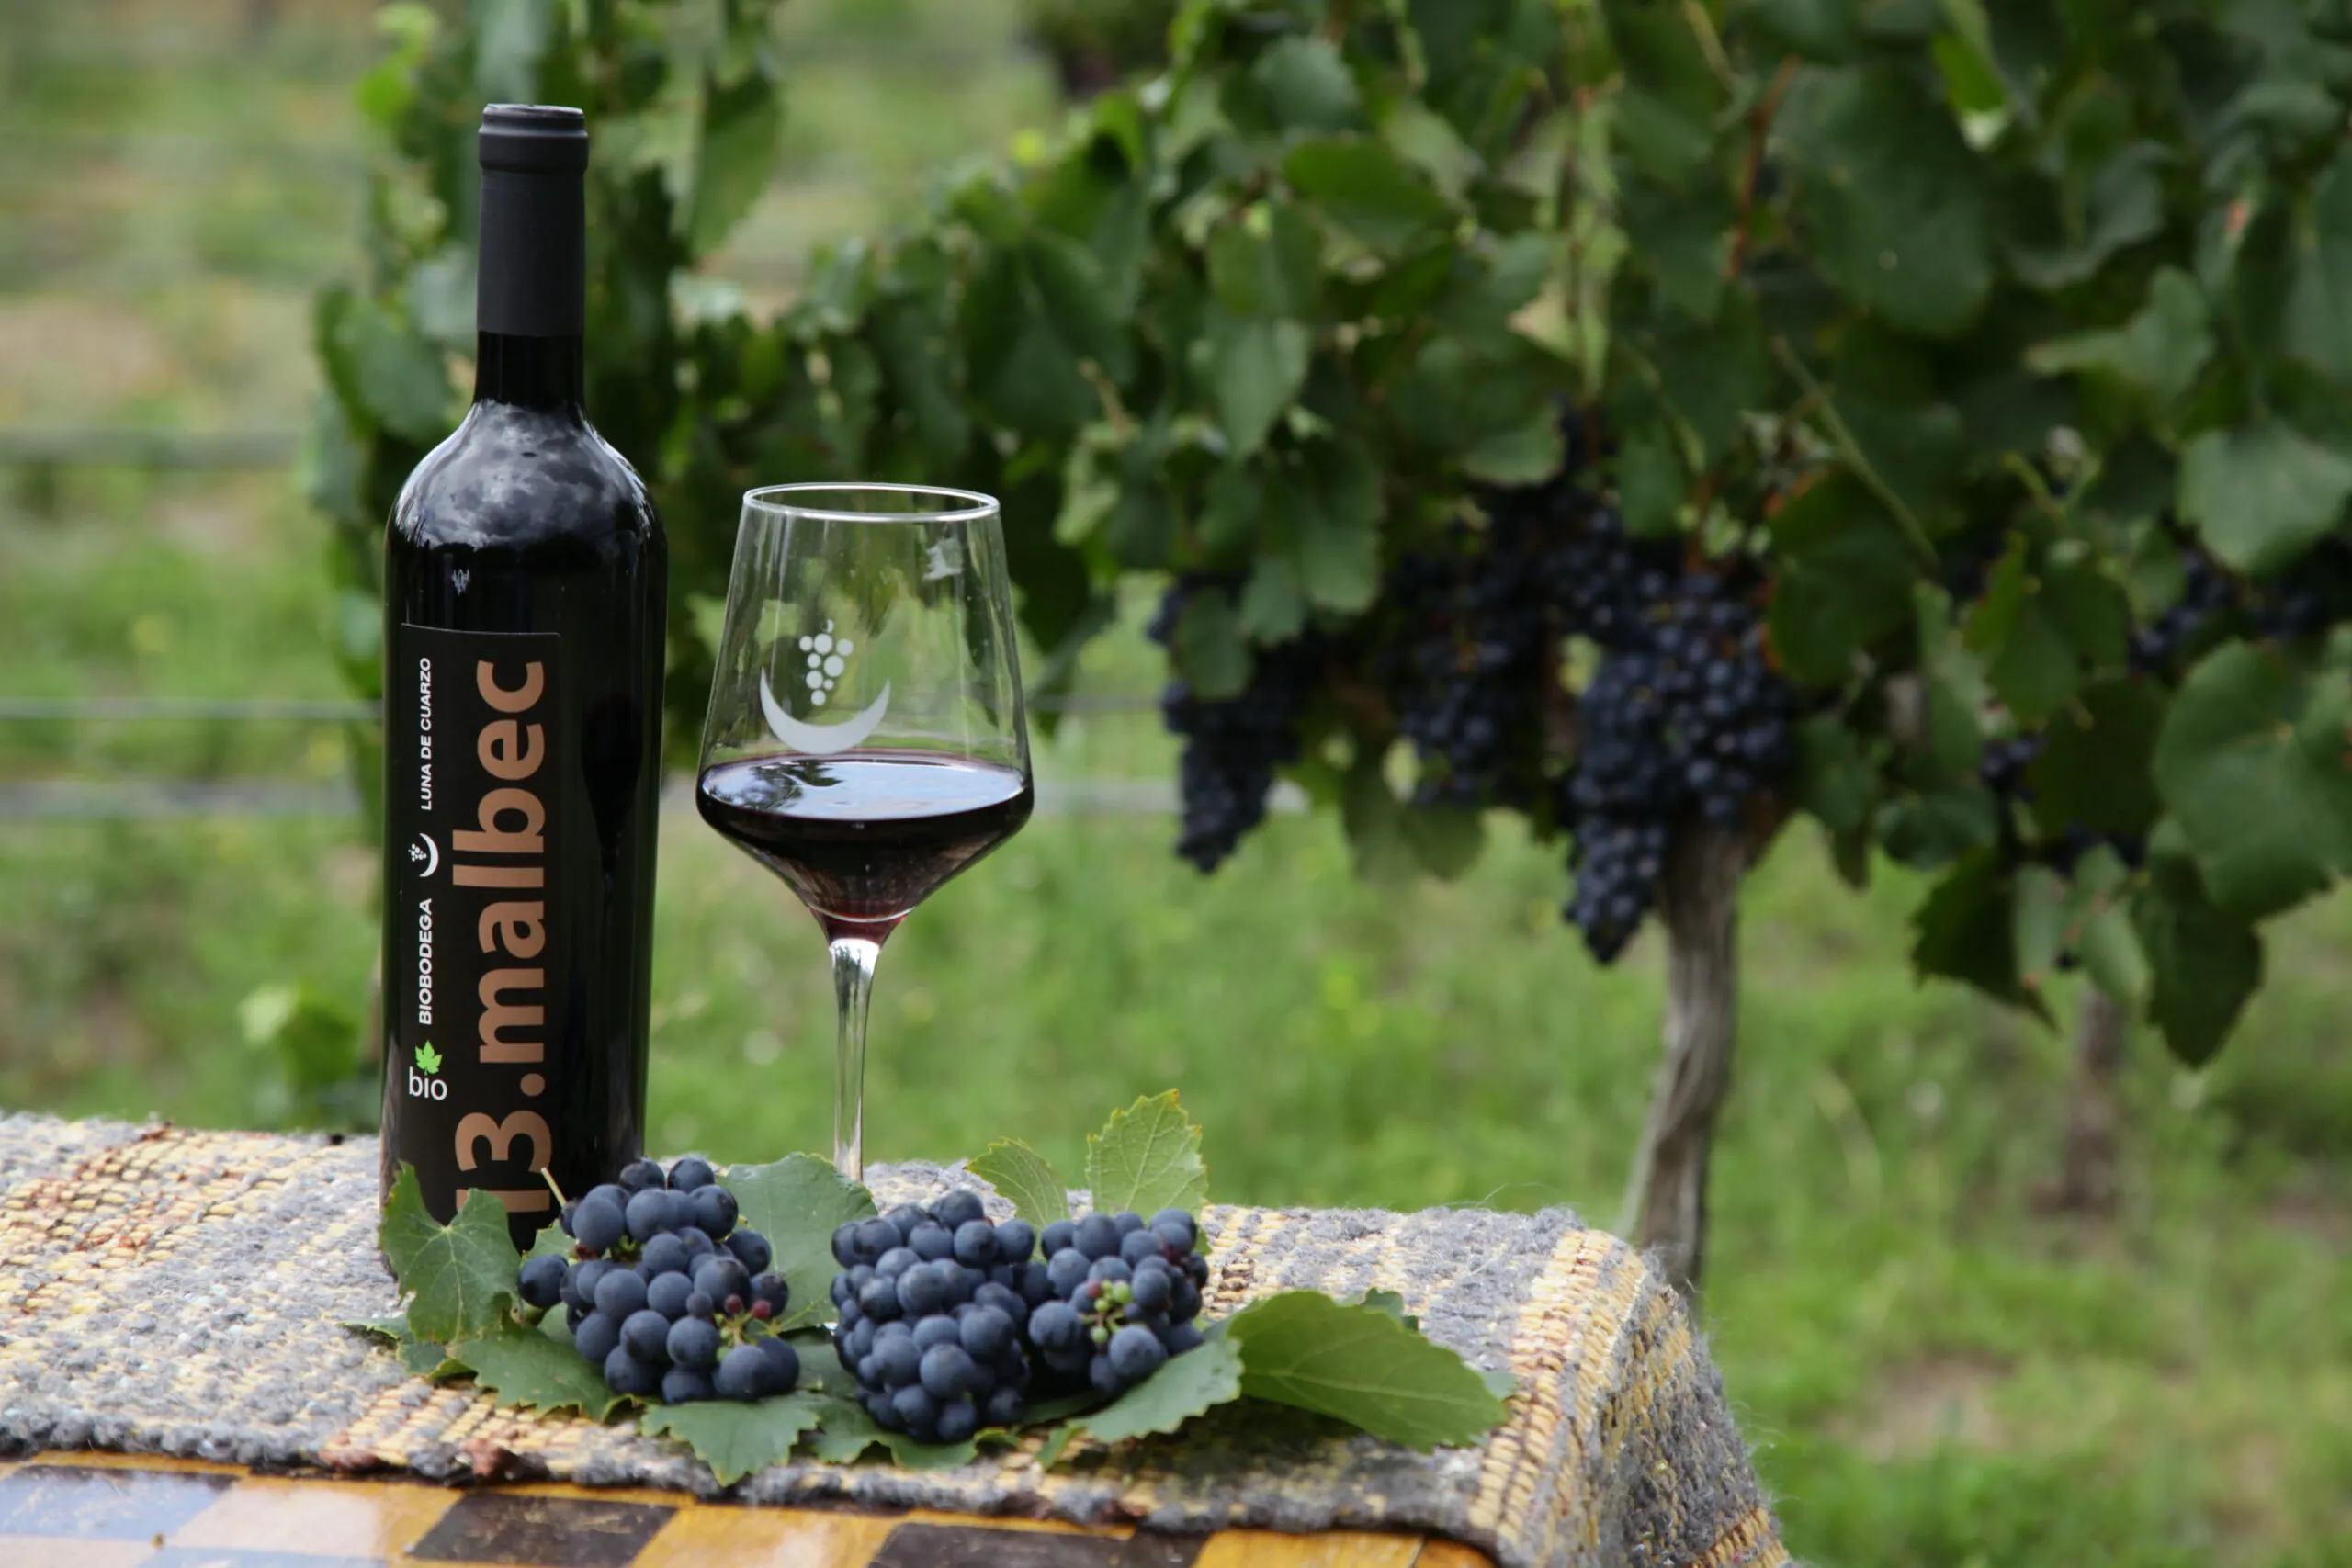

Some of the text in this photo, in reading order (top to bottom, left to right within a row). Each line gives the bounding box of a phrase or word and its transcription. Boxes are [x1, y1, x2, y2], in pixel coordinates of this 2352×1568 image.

[418, 657, 433, 1025] BIOBODEGA LUNA DE CUARZO
[408, 1066, 448, 1101] bio
